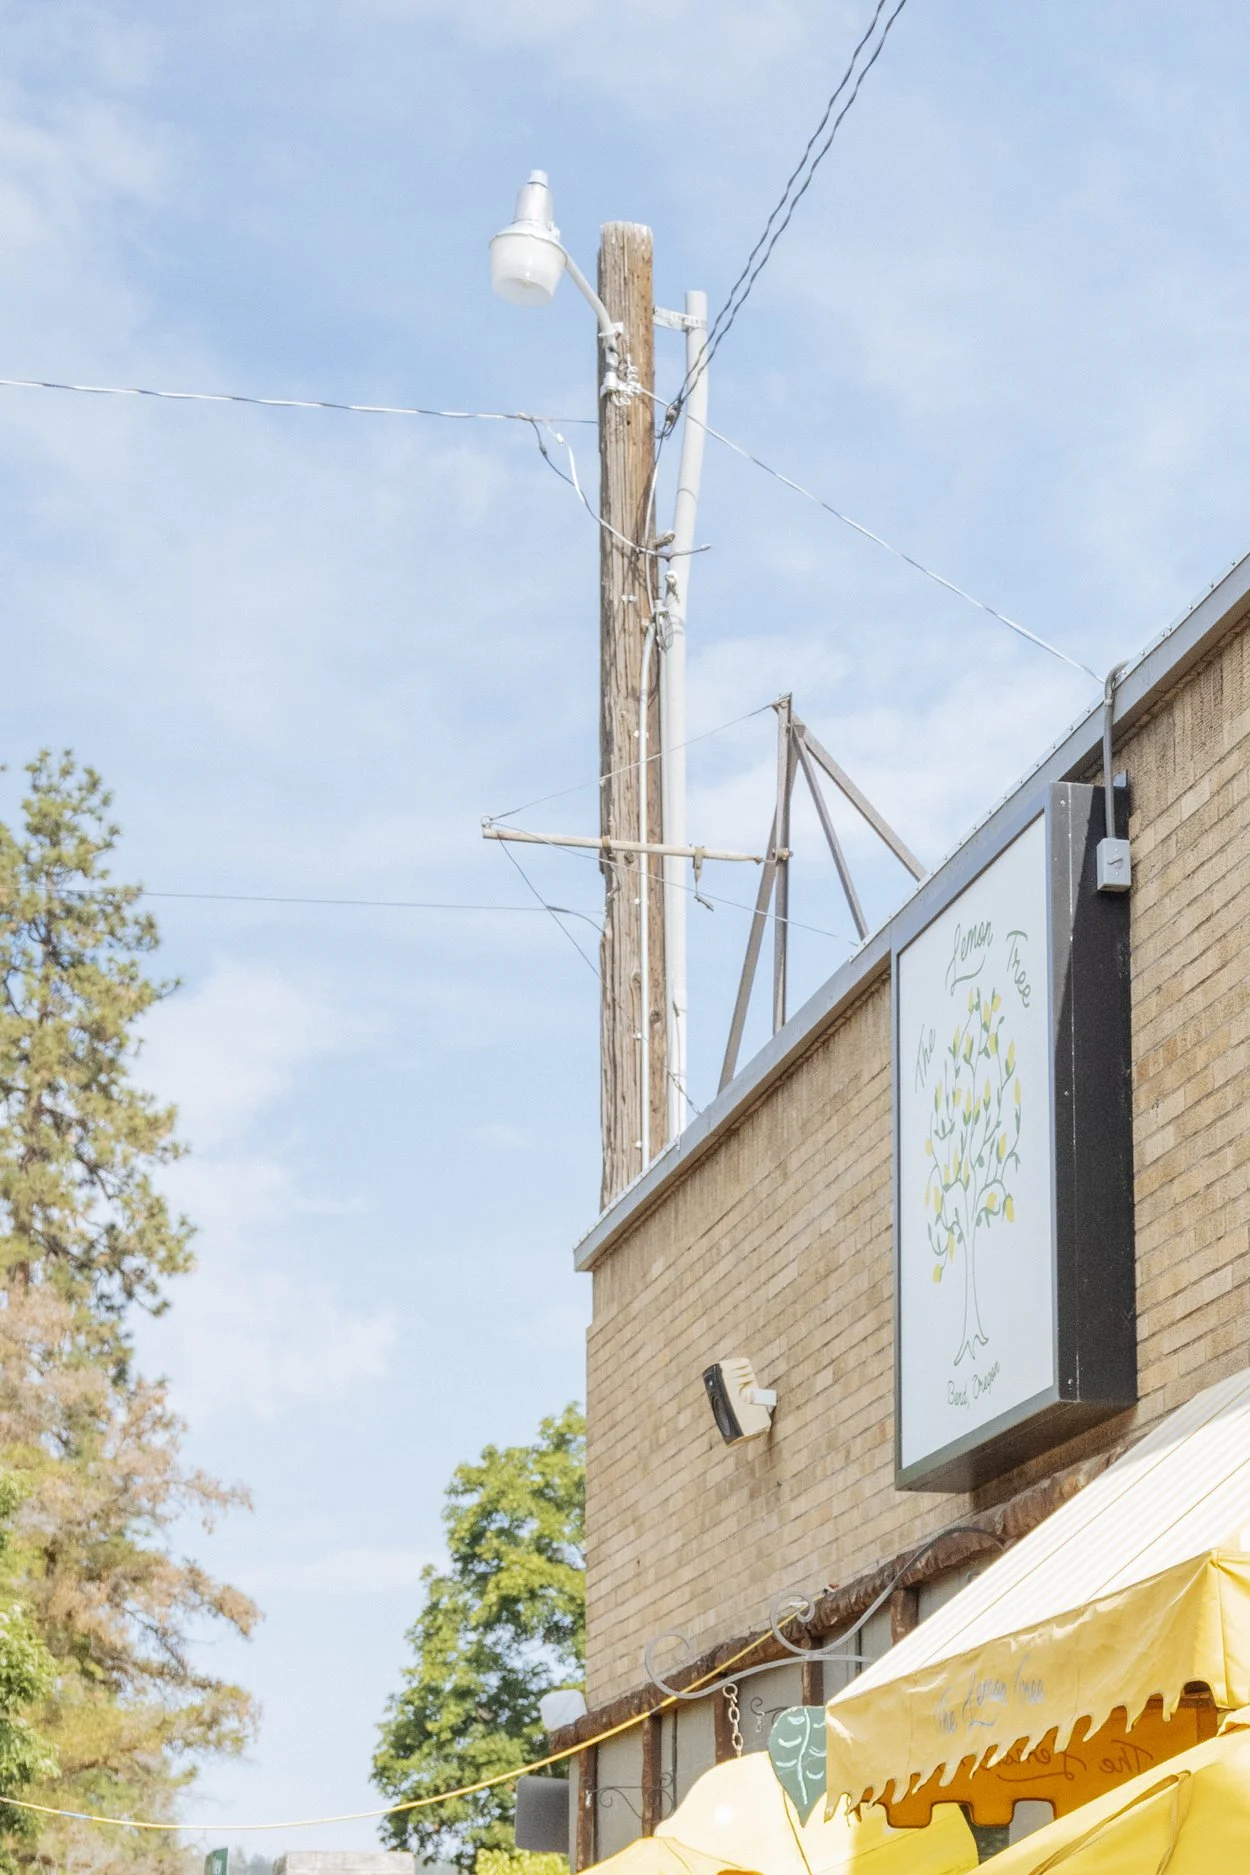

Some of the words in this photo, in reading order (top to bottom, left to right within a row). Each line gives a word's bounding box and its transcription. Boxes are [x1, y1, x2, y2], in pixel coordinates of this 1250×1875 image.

[915, 1024, 936, 1093] The
[945, 920, 993, 996] Lemon
[1006, 930, 1032, 1009] Tree
